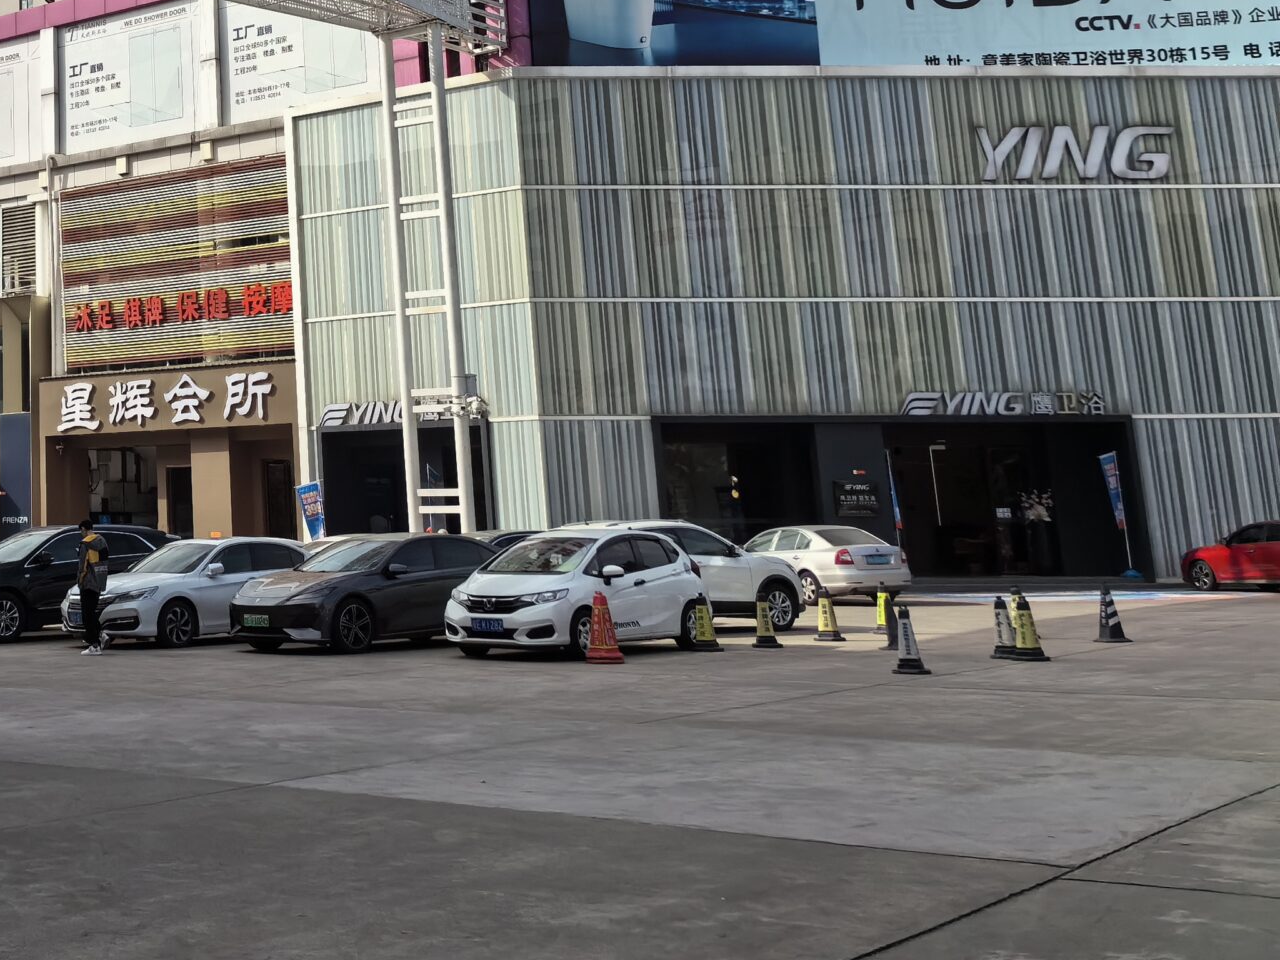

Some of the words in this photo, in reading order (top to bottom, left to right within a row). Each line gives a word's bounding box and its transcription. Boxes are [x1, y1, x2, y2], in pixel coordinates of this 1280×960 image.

[134, 17, 142, 25] DO
[144, 12, 168, 22] SHOWER
[975, 125, 1175, 181] YING
[124, 295, 163, 329] 棋牌
[176, 288, 230, 323] 保健
[242, 280, 293, 316] 按摩
[57, 371, 273, 433] 星辉会所
[1029, 391, 1106, 415] 鹰卫浴
[2, 516, 28, 524] FAENZA
